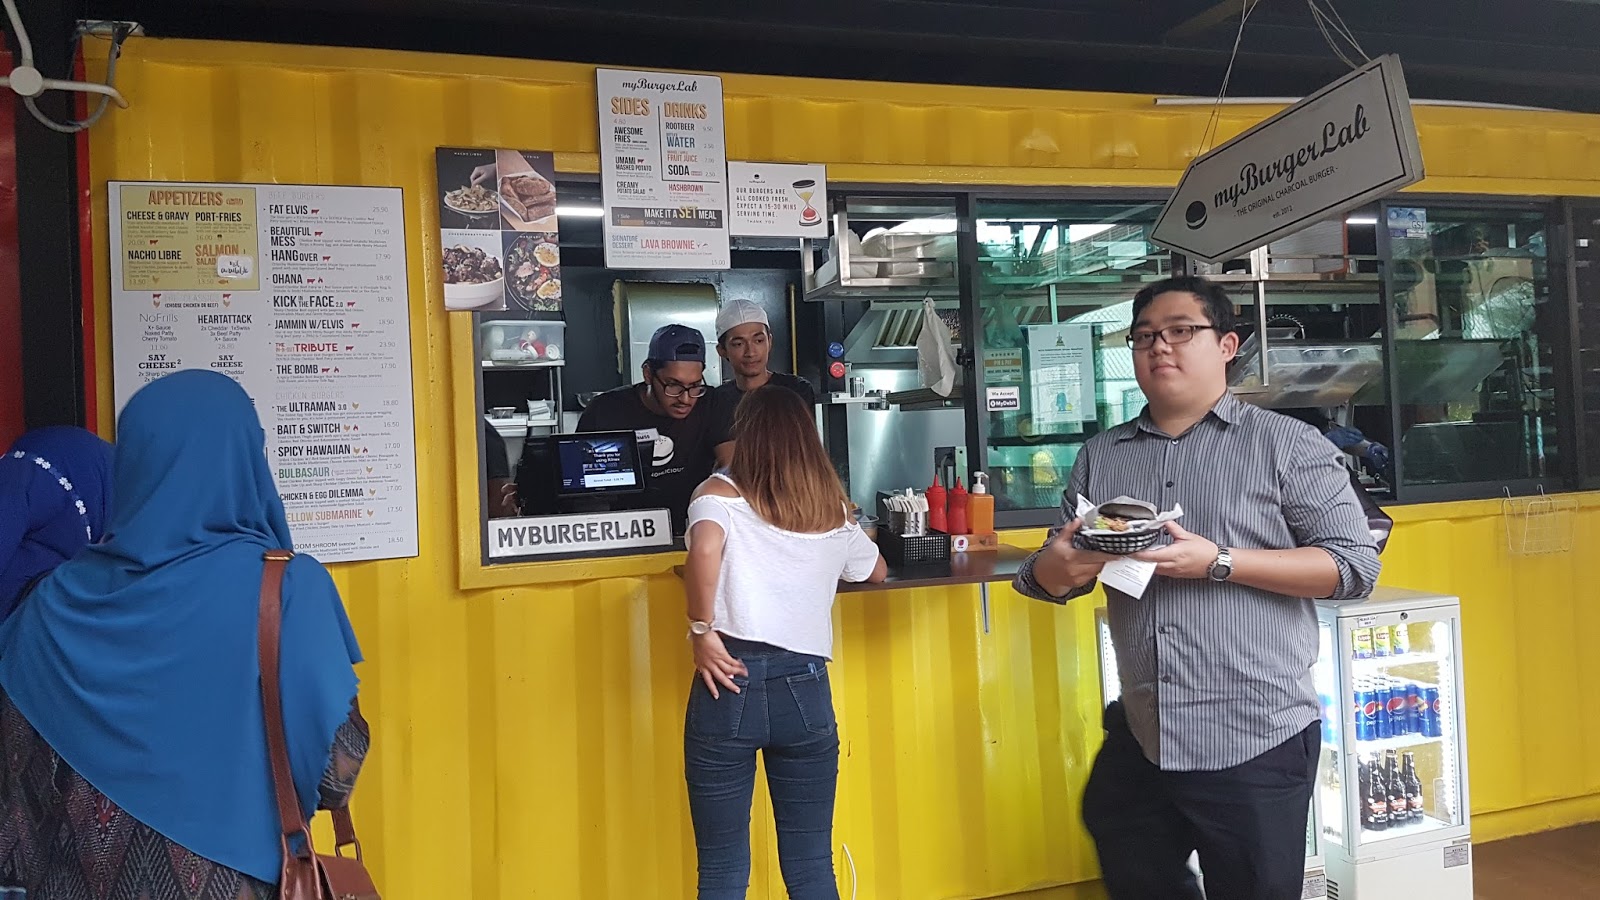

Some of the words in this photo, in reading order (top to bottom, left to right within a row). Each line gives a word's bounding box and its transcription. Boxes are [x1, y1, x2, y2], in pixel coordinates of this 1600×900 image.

[622, 78, 698, 93] myBurgerLab
[611, 96, 650, 116] SIDES
[664, 101, 707, 119] DRINKS
[614, 126, 643, 136] AWESOME
[666, 122, 694, 131] ROOTBEER
[614, 135, 631, 143] FRIES
[667, 137, 695, 148] WATER
[1214, 104, 1371, 208] myBurgerLab
[668, 165, 690, 176] SODA
[669, 184, 703, 192] HASHBROWN
[1236, 206, 1248, 218] THE
[1247, 195, 1274, 214] ORIGINAL
[1275, 180, 1308, 199] CHARCOAL
[1309, 166, 1335, 185] BURGER
[149, 191, 223, 205] APPETIZERS
[269, 204, 283, 215] FAT
[286, 205, 308, 215] ELVIS
[645, 209, 664, 218] MAKE
[665, 210, 671, 218] IT
[673, 210, 677, 218] A
[679, 206, 697, 219] SET
[699, 210, 716, 219] MEAL
[127, 211, 155, 220] CHEESE
[158, 212, 163, 220] &
[165, 212, 189, 220] GRAVY
[195, 212, 241, 222] PORT-FRIES
[270, 226, 311, 236] BEAUTIFUL
[271, 236, 295, 246] MESS
[641, 239, 659, 249] LAVA
[661, 240, 695, 249] BROWNIE
[128, 250, 157, 260] NACHO
[159, 250, 181, 260] LIBRE
[195, 244, 239, 257] SALMON
[196, 258, 217, 266] SALAD
[273, 274, 302, 284] OHANA
[273, 295, 297, 307] KICK
[310, 296, 334, 307] FACE
[140, 313, 178, 322] NoFrills
[198, 315, 252, 324] HEARTATTACK
[275, 320, 307, 329] JAMMIN
[309, 320, 344, 329] W/ELVIS
[294, 343, 338, 352] TRIBUTE
[277, 365, 292, 374] THE
[294, 365, 318, 374] BOMB
[289, 401, 336, 412] ULTRAMAN
[277, 424, 297, 435] BAIT
[300, 424, 305, 434] &
[308, 423, 340, 433] SWITCH
[278, 446, 304, 457] SPICY
[307, 444, 350, 456] HAWAIIAN
[279, 467, 330, 479] BULBASAUR
[280, 493, 307, 501] CHICKEN
[310, 492, 314, 500] &
[329, 488, 364, 499] DILEMMA
[287, 511, 313, 522] ELLOW
[315, 508, 362, 520] SUBMARINE
[498, 518, 656, 548] MYBURGERLAB
[312, 541, 337, 549] SHROOM
